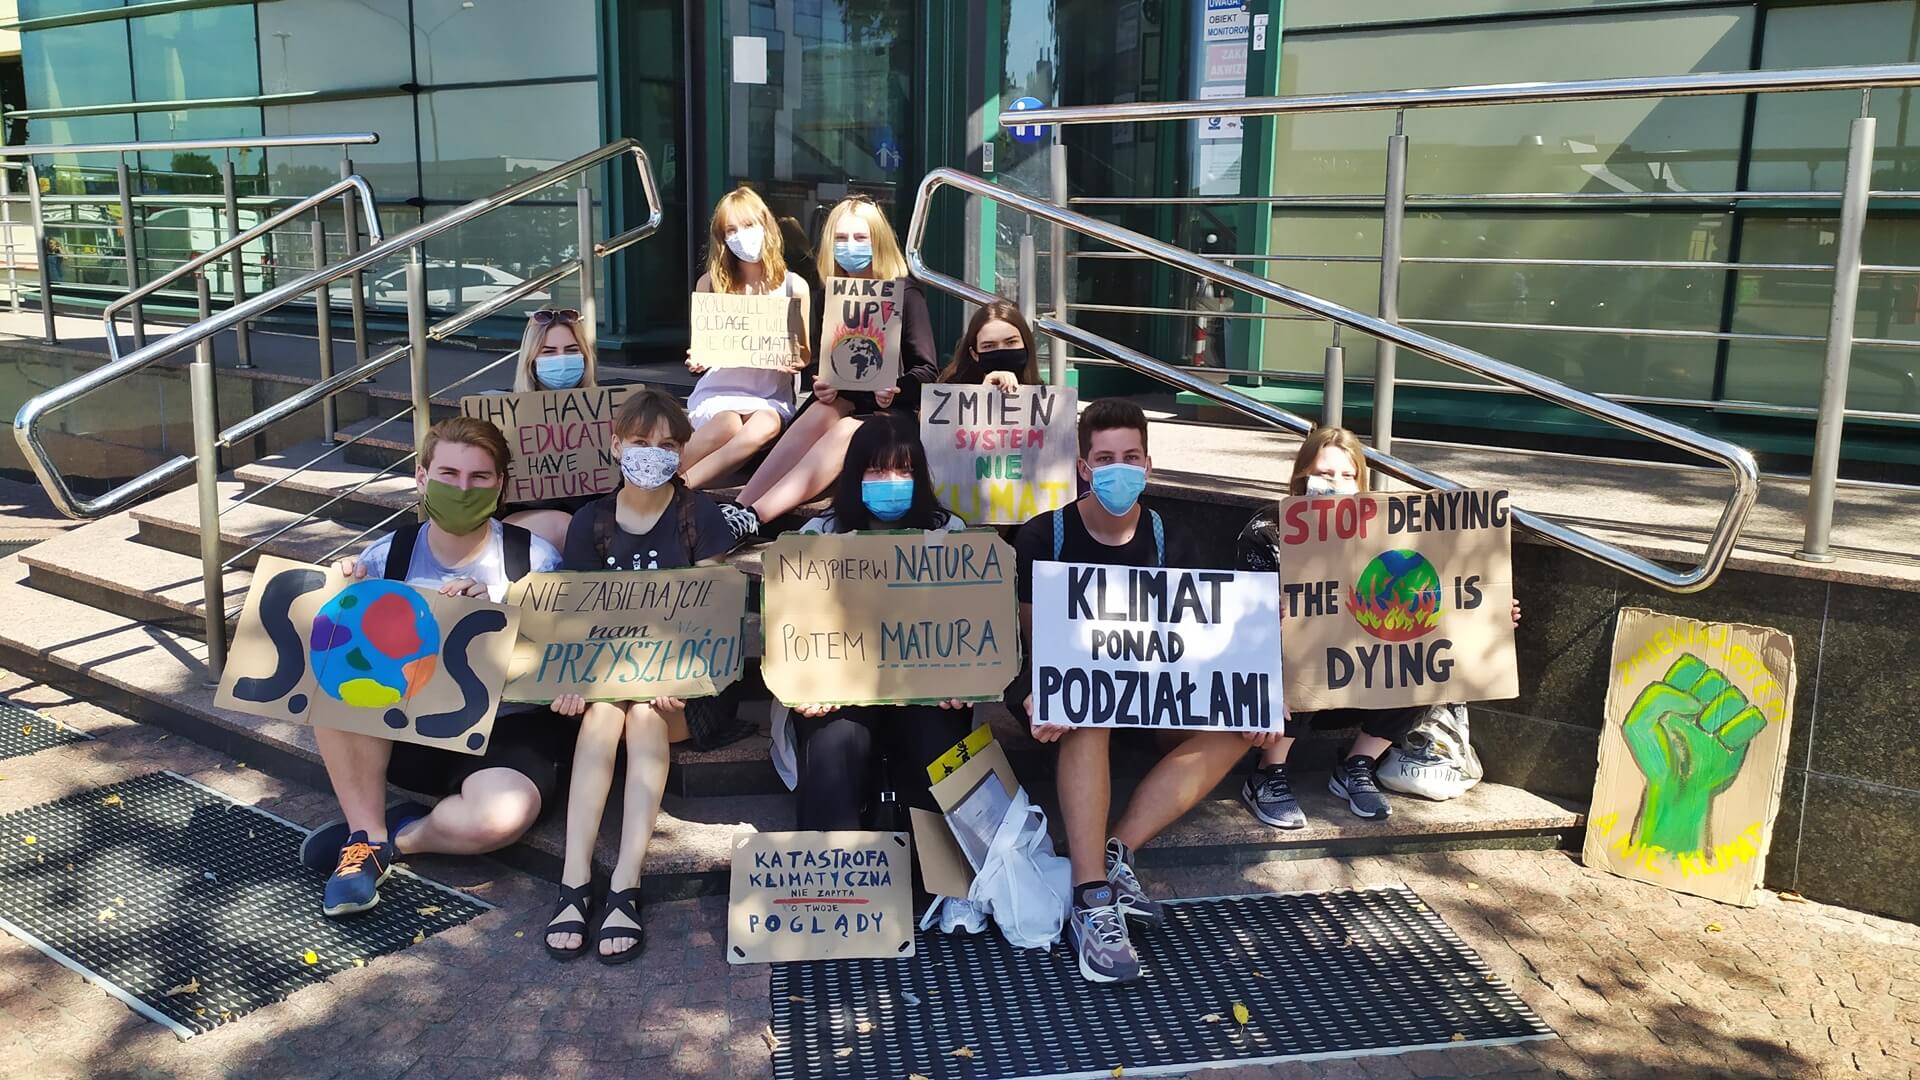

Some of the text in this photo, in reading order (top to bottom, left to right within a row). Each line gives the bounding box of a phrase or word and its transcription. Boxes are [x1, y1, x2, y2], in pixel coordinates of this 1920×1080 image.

[1208, 14, 1237, 24] OBIEKT
[833, 279, 895, 297] WAKE
[929, 385, 1055, 426] ZMIEŃ
[955, 428, 1044, 450] SYSTEM
[528, 453, 577, 476] HAVE
[975, 454, 1022, 480] NIE
[515, 468, 612, 501] FUTURE
[1283, 489, 1510, 545] STOP DENYING
[895, 543, 1003, 582] NATURA
[519, 579, 721, 621] NIE ZABIERAJCIE
[1067, 566, 1235, 624] KLIMAT
[1283, 575, 1483, 618] THE IS
[588, 624, 653, 641] nam
[782, 618, 999, 662] POTEM MATURA
[1091, 629, 1185, 663] PONAD
[1326, 638, 1455, 690] DYING
[1039, 666, 1271, 728] PODZIAŁAMI
[755, 848, 889, 869] KATASTROFA
[1613, 832, 1665, 875] NIE
[749, 870, 892, 888] KLIMATYCZNA
[791, 888, 855, 898] NIE ZAPYTA
[749, 911, 883, 937] POGLĄDY
[804, 904, 840, 912] TWOJE
